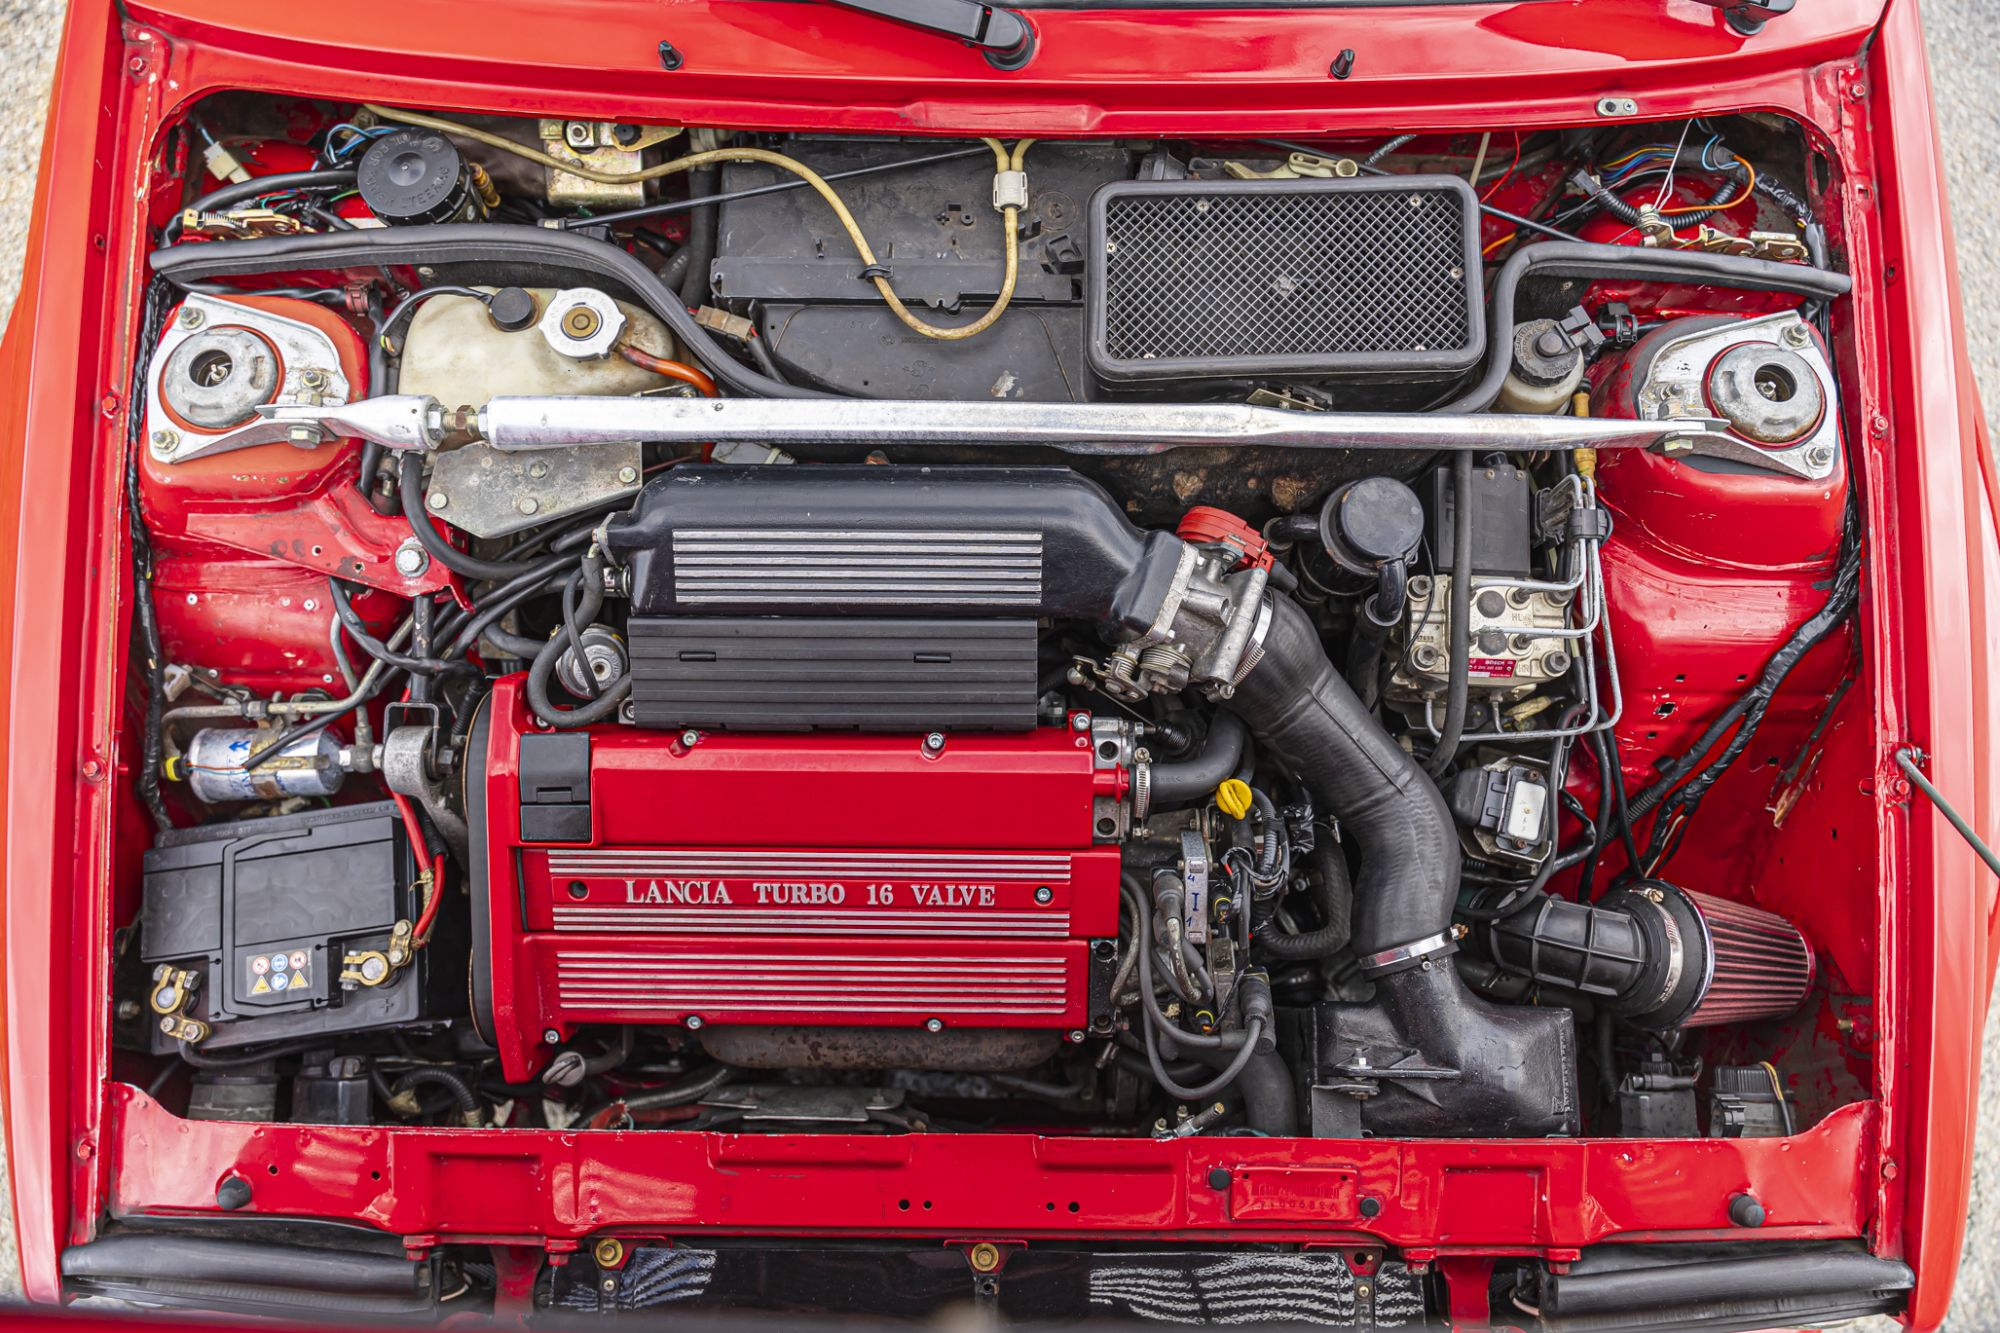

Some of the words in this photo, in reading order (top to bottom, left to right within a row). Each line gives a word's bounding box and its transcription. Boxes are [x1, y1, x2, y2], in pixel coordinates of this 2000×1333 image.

[367, 144, 389, 166] FOR
[1187, 874, 1196, 882] 4
[624, 880, 733, 904] LANCIA
[753, 882, 846, 905] TURBO
[866, 884, 894, 905] 16
[911, 885, 996, 906] VALVE
